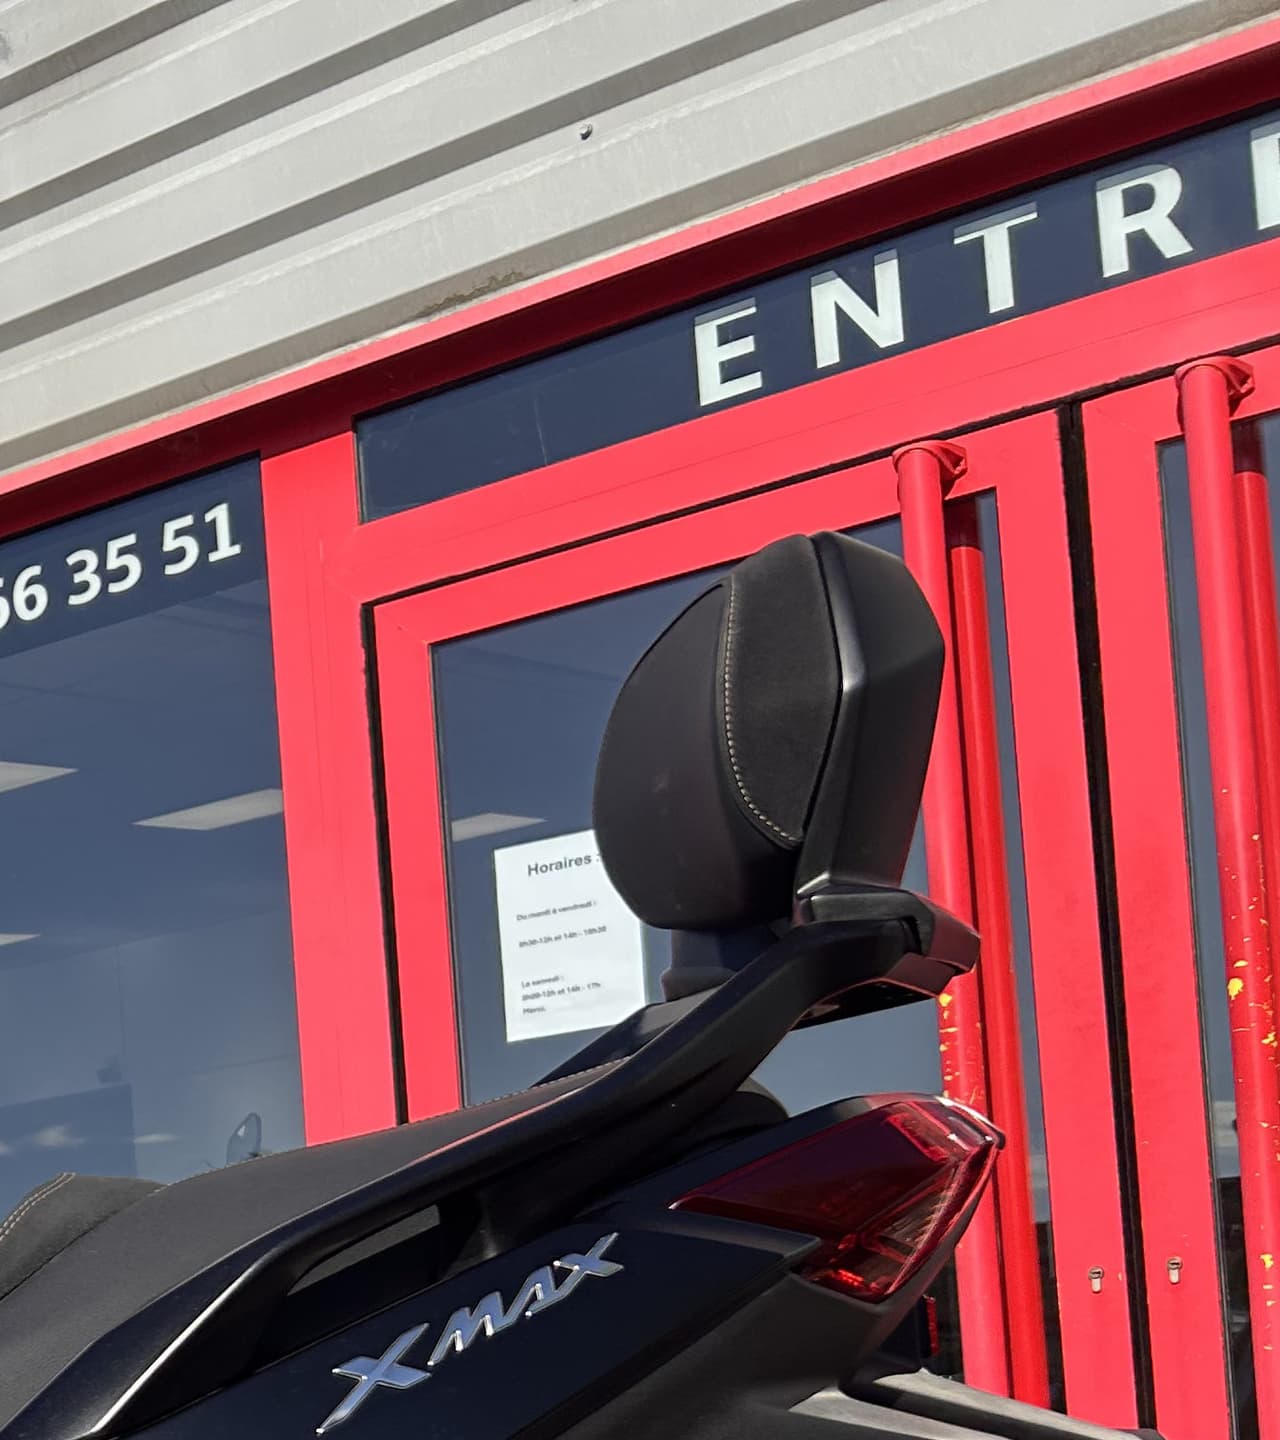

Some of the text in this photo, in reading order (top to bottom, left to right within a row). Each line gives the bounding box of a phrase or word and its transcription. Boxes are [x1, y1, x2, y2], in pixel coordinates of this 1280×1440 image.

[67, 532, 143, 608] 35
[161, 502, 241, 577] 51
[528, 855, 591, 876] Horaires
